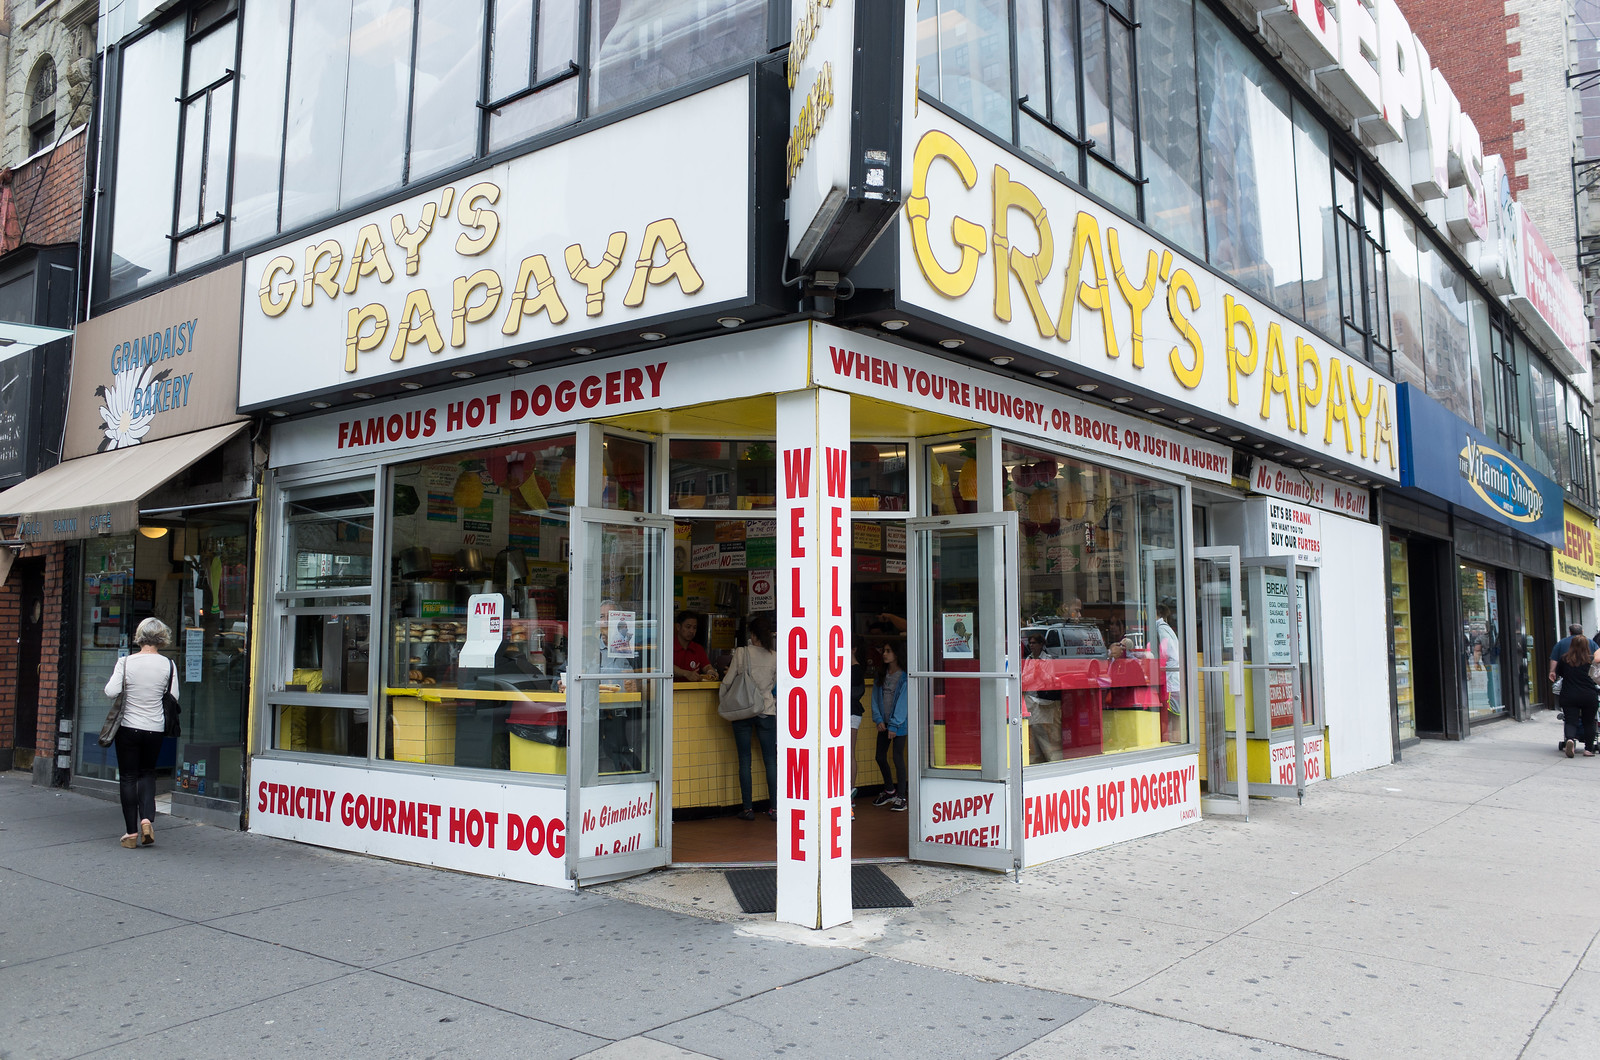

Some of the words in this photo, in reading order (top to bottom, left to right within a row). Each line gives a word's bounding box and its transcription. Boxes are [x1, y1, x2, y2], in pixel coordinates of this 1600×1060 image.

[258, 181, 501, 318] GRAY'S
[344, 217, 705, 374] PAPAYA
[907, 129, 1205, 389] GRAY'S
[1223, 293, 1398, 470] PAPAYA
[111, 318, 198, 376] GRANDAISY
[132, 372, 193, 420] BAKERY
[337, 407, 437, 450] FAMOUS
[447, 394, 501, 432] HOT
[510, 361, 668, 421] DOGGERY
[829, 345, 899, 389] WHEN
[903, 368, 971, 408] YOU'RE
[974, 387, 1049, 432] HUNGRY,
[1051, 408, 1072, 433] OR
[1074, 416, 1123, 451] BROKE,
[1124, 433, 1142, 454] OR
[1143, 436, 1169, 458] JUST
[1169, 442, 1181, 460] IN
[1182, 447, 1191, 465] A
[1191, 447, 1228, 475] HURRY!
[1257, 465, 1271, 489] No
[1334, 487, 1345, 508] No
[1346, 491, 1366, 515] Bull!
[1459, 456, 1469, 474] THE
[1466, 434, 1510, 498] Vitamin
[1510, 471, 1544, 516] Shoppe
[464, 534, 476, 545] NO
[1285, 508, 1292, 521] BE
[1292, 510, 1312, 526] FRANK
[720, 555, 732, 567] NO
[1271, 532, 1284, 546] BUY
[1285, 534, 1297, 548] OUR
[1297, 537, 1320, 552] FURTERS
[475, 603, 496, 614] ATM
[1266, 582, 1303, 596] BREAKST
[783, 447, 812, 862] WELCOME
[825, 446, 847, 860] WELCOME
[1303, 740, 1323, 755] OURMET
[257, 781, 336, 823] STRICTLY
[341, 792, 442, 840] GOURMET
[449, 807, 499, 849] HOT
[506, 813, 566, 859] DOG
[582, 810, 596, 834] No
[599, 792, 654, 827] Gimmicks!
[932, 793, 994, 824] SNAPPY
[1025, 785, 1090, 840] FAMOUS
[1097, 780, 1125, 823] HOT
[1180, 807, 1198, 821] (ANON)
[925, 825, 1000, 848] RVICE!!
